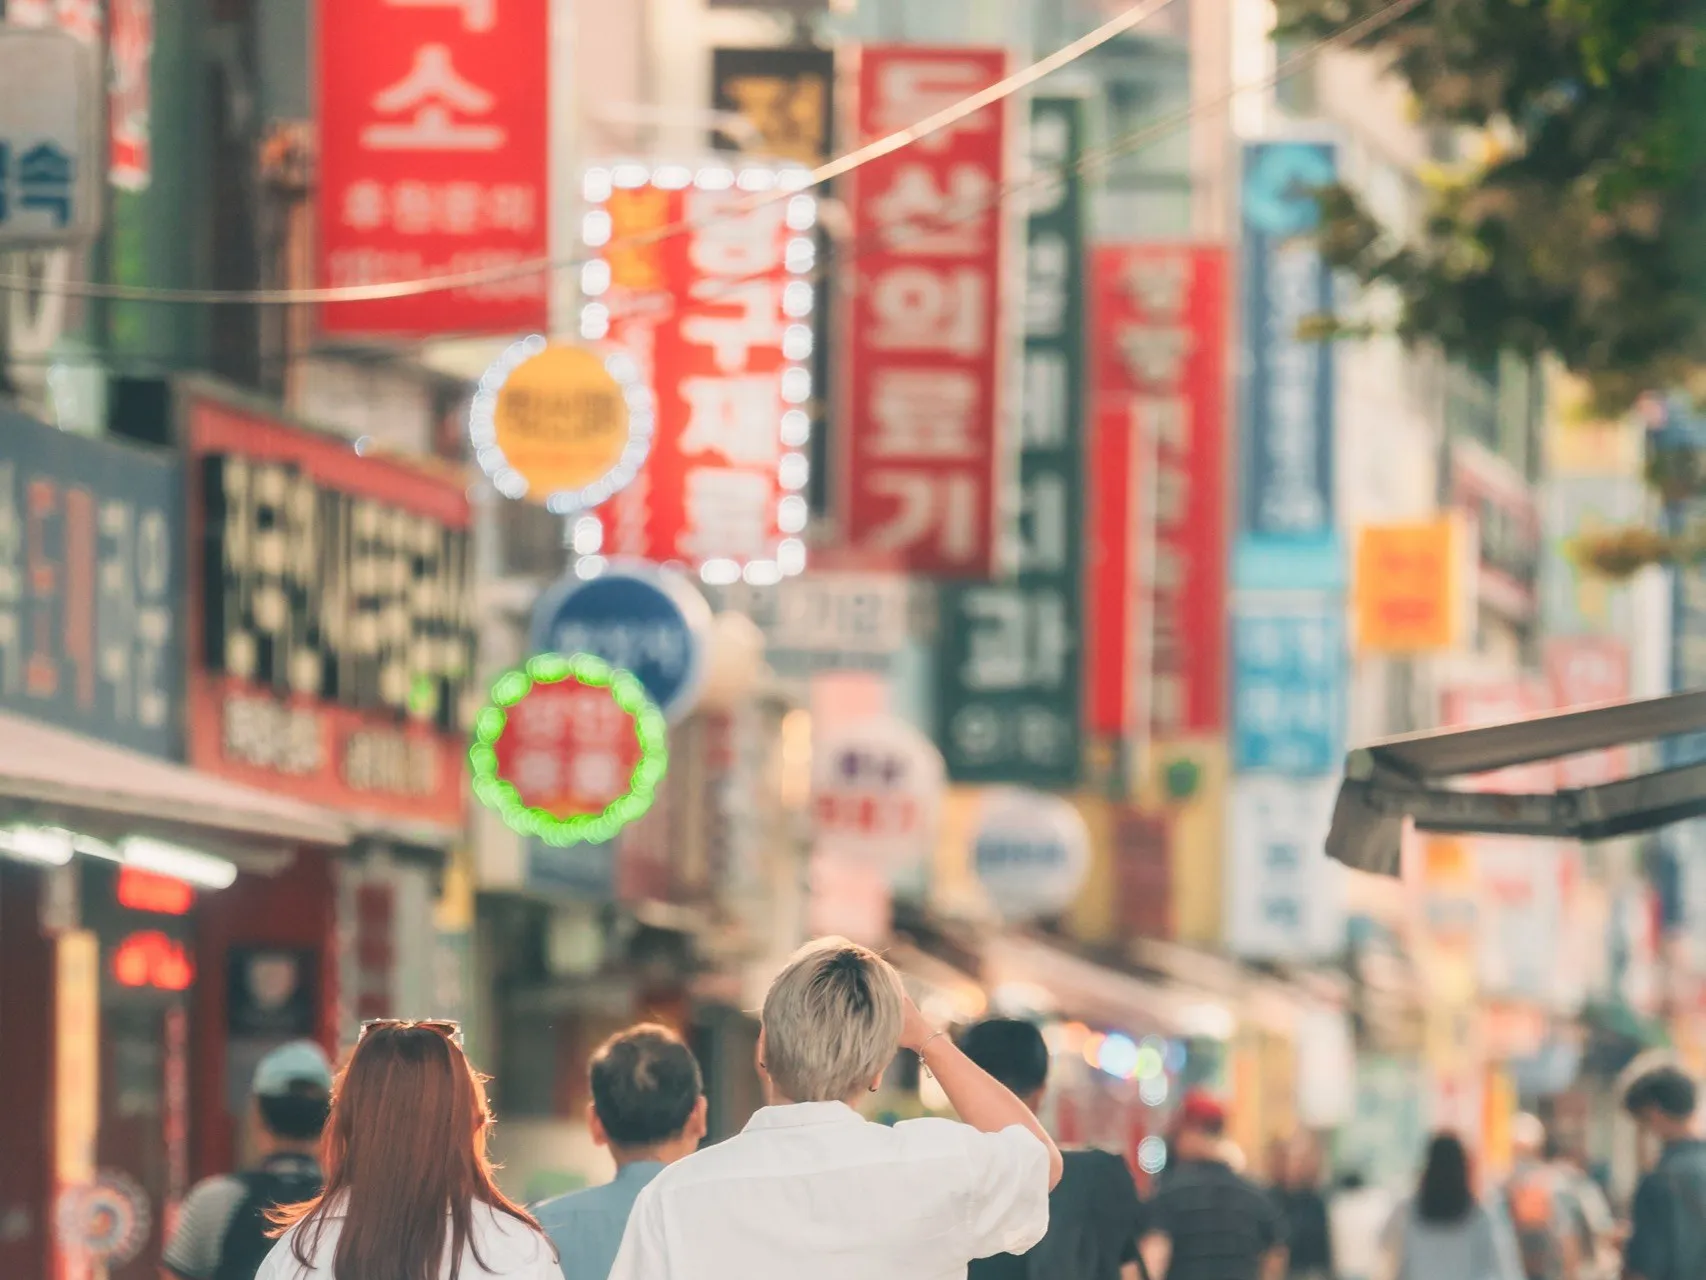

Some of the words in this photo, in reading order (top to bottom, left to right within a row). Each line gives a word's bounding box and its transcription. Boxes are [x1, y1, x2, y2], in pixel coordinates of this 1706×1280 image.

[362, 0, 508, 149] 소
[0, 140, 74, 227] 속
[863, 58, 989, 557] 두산의료기
